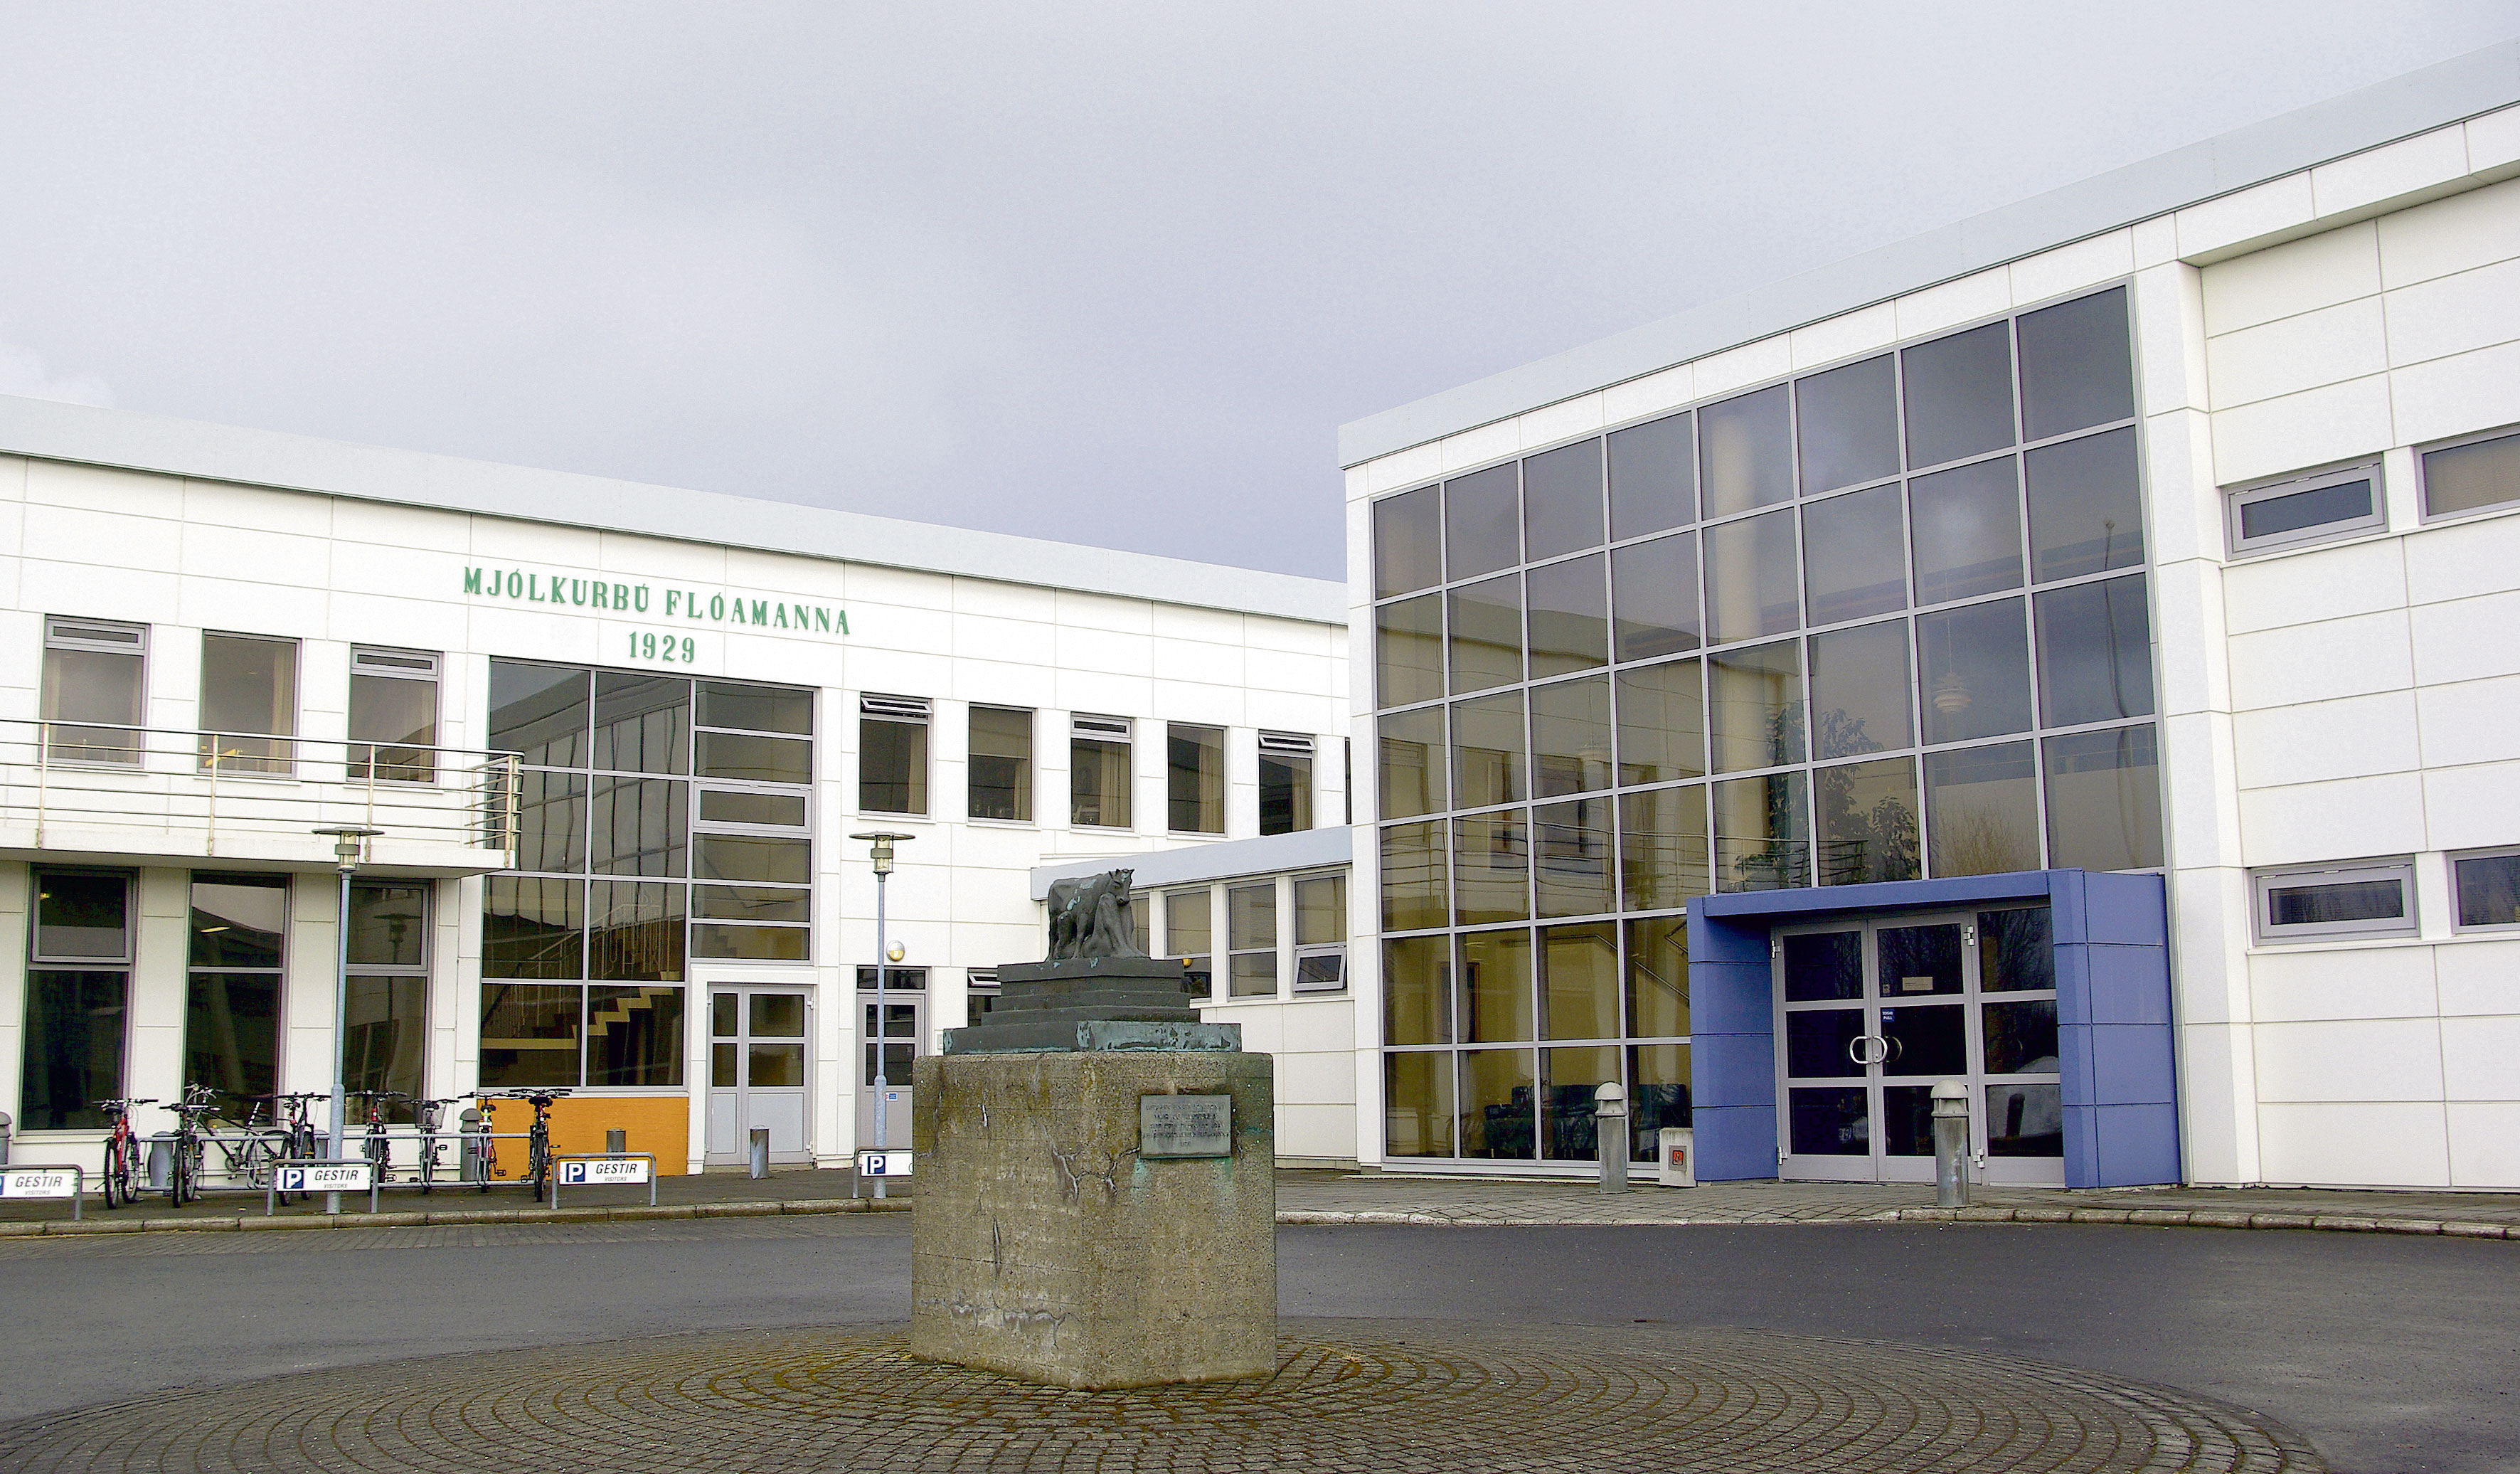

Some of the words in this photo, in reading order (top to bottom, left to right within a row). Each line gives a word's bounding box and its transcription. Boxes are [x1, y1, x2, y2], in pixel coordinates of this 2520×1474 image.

[463, 566, 649, 613] MJÓLKURBÚ
[665, 592, 850, 635] FLÓAMANNA
[629, 631, 695, 671] 1929
[568, 1163, 583, 1182] P
[595, 1163, 637, 1174] GESTIR
[869, 1156, 884, 1174] P
[16, 1176, 63, 1187] GESTIR
[285, 1170, 302, 1189] P
[314, 1170, 358, 1181] GESTIR
